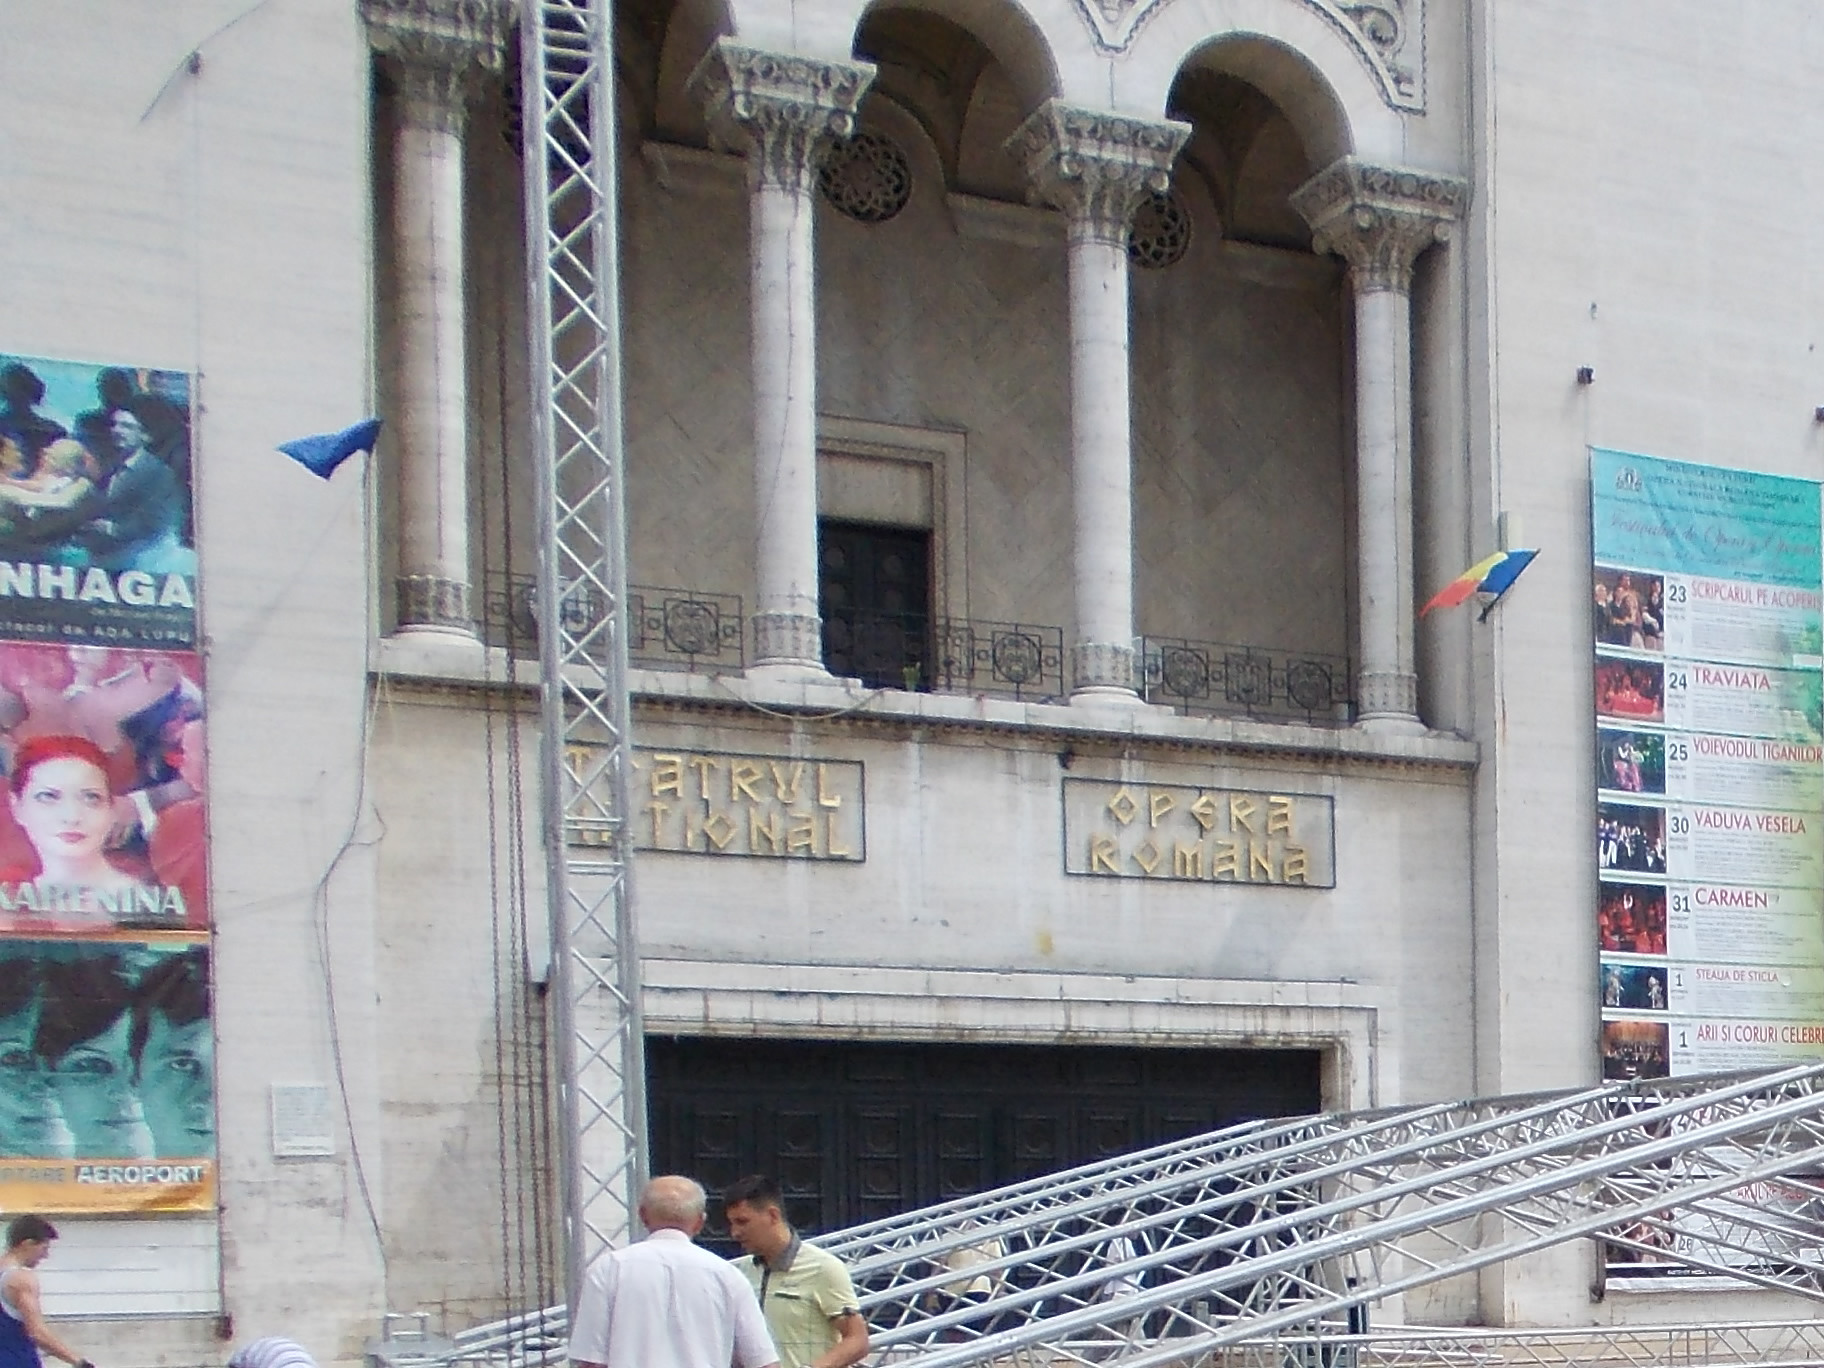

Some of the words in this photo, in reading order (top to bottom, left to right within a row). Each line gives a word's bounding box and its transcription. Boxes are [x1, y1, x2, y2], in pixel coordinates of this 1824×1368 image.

[0, 561, 194, 608] NHAGA
[1669, 583, 1687, 603] 23
[1691, 580, 1753, 604] SCRIPCARUL
[1669, 672, 1688, 691] 24
[1693, 666, 1771, 691] TRAVIATA
[1669, 743, 1688, 762] 25
[1693, 737, 1758, 759] VOIEVODUL
[1762, 742, 1823, 764] TIGANILOR
[565, 747, 844, 808] TATRUL
[1107, 785, 1294, 835] OPERA
[580, 800, 850, 856] TIONAL
[1671, 816, 1690, 834] 30
[1694, 810, 1752, 831] VADUVA
[1756, 814, 1806, 834] VESELA
[1089, 832, 1309, 883] ROMANA
[1672, 895, 1692, 913] 31
[1695, 887, 1768, 909] CARMEN
[1675, 973, 1684, 988] 1
[1696, 968, 1730, 981] STEAUA
[1733, 969, 1745, 982] DE
[1748, 971, 1779, 983] STICLA
[1679, 1030, 1688, 1049] 1
[1696, 1024, 1718, 1042] ARII
[1734, 1025, 1778, 1043] CORURI
[77, 1165, 204, 1184] AEROPORT
